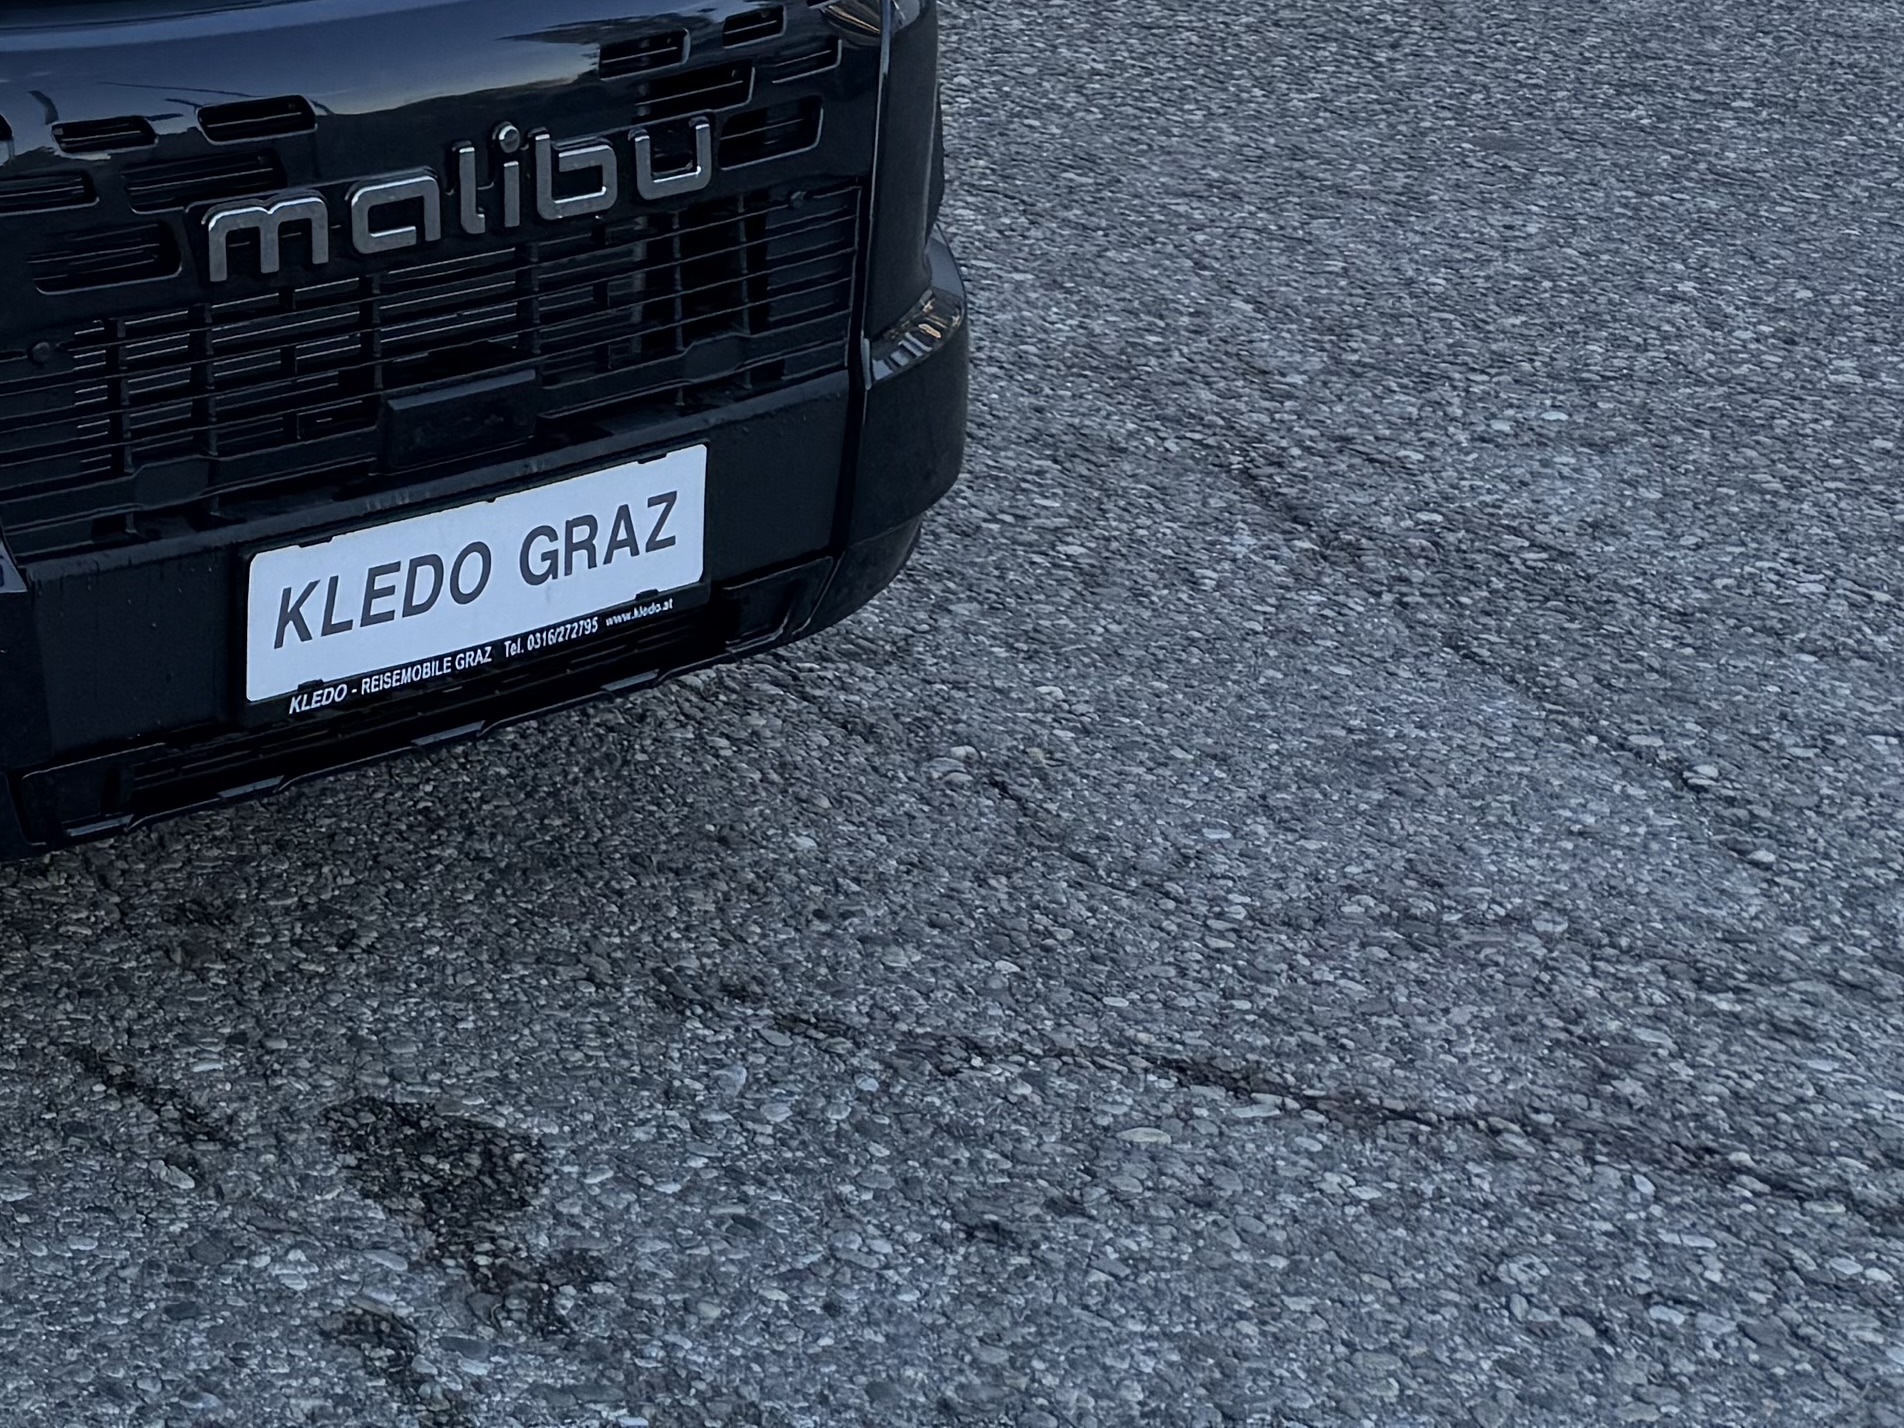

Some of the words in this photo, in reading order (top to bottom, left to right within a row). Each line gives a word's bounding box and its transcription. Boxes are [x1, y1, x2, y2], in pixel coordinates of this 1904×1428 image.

[200, 117, 713, 282] malibu
[273, 540, 492, 649] KLEDO
[518, 490, 679, 588] GRAZ
[288, 682, 348, 715] KLEDO
[361, 657, 453, 695] REISEMOBILE
[454, 646, 493, 670] GRAZ
[503, 639, 525, 658] Tel.
[526, 615, 599, 651] 0316/272795
